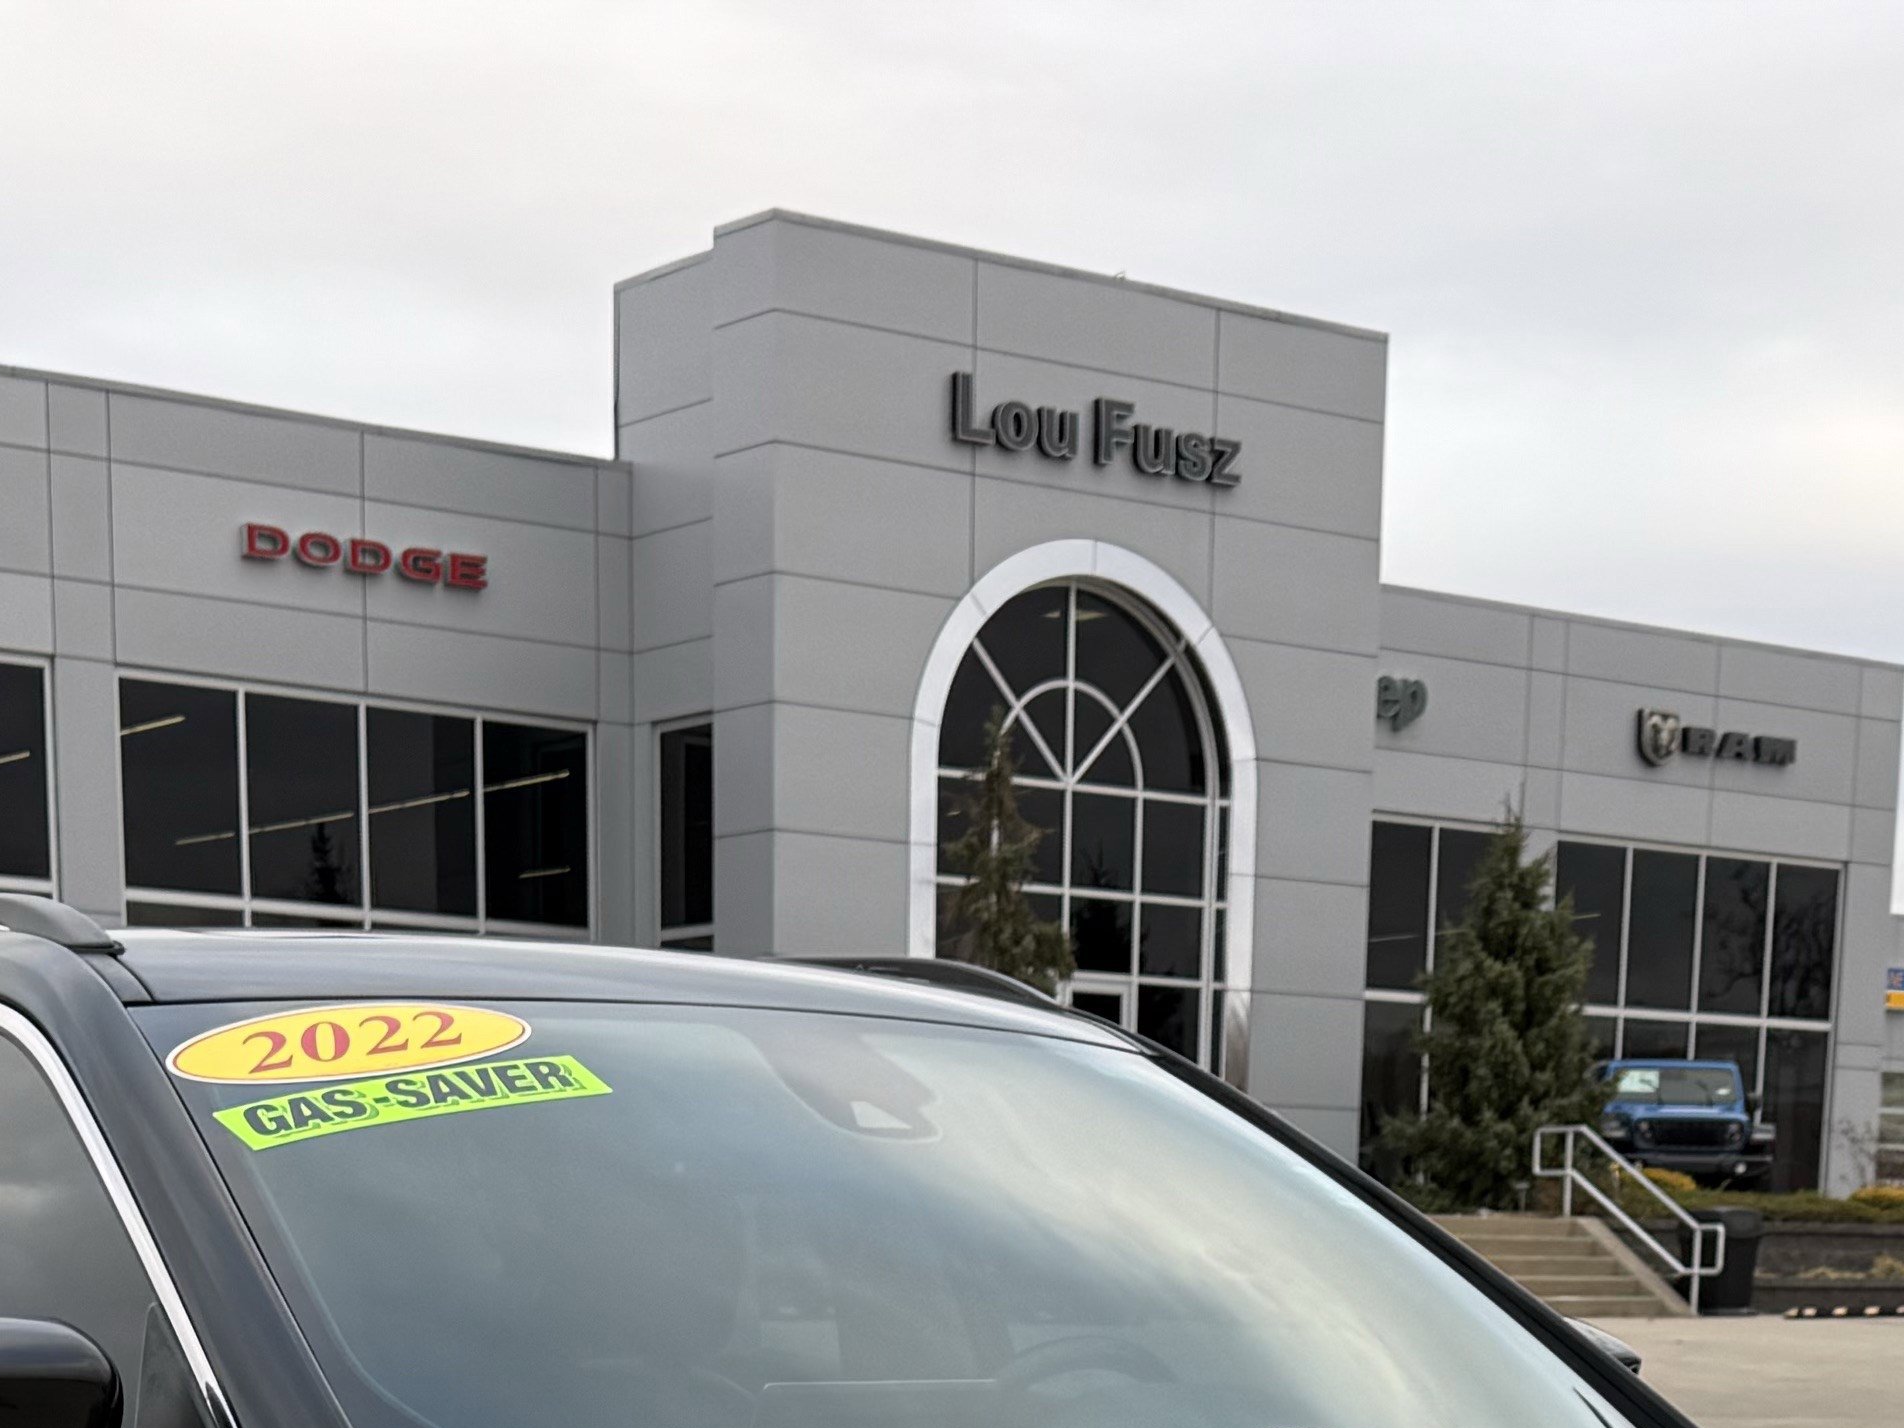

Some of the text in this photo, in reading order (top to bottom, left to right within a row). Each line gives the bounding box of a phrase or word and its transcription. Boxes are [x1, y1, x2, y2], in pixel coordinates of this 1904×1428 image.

[949, 370, 1242, 486] Lou Fusz
[241, 522, 489, 590] DODGE
[1681, 727, 1796, 767] RAM
[242, 1010, 463, 1075] 2022
[242, 1059, 578, 1139] GAS-SAVER
